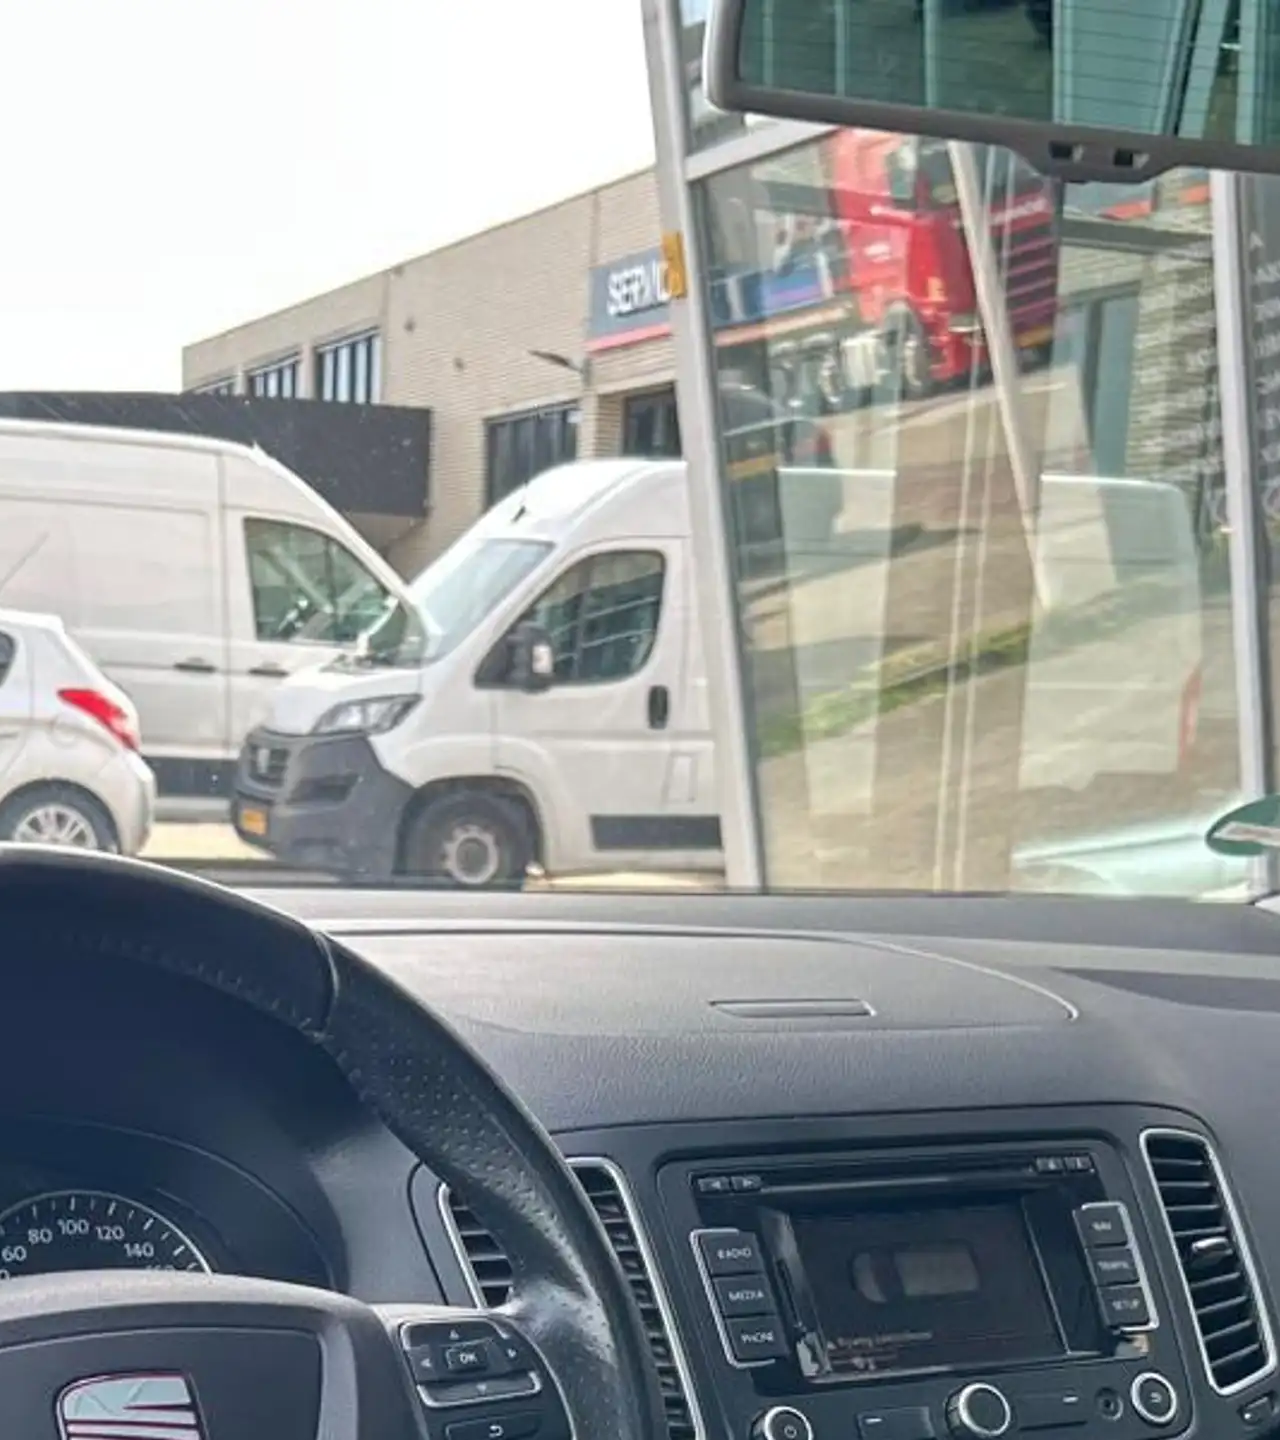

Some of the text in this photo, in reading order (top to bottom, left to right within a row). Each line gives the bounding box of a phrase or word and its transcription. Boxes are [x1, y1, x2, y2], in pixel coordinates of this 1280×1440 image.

[56, 1218, 90, 1236] 100
[95, 1225, 125, 1242] 120
[28, 1227, 53, 1245] 80
[1, 1245, 27, 1263] 60
[123, 1242, 155, 1259] 140
[459, 1352, 478, 1364] OK
